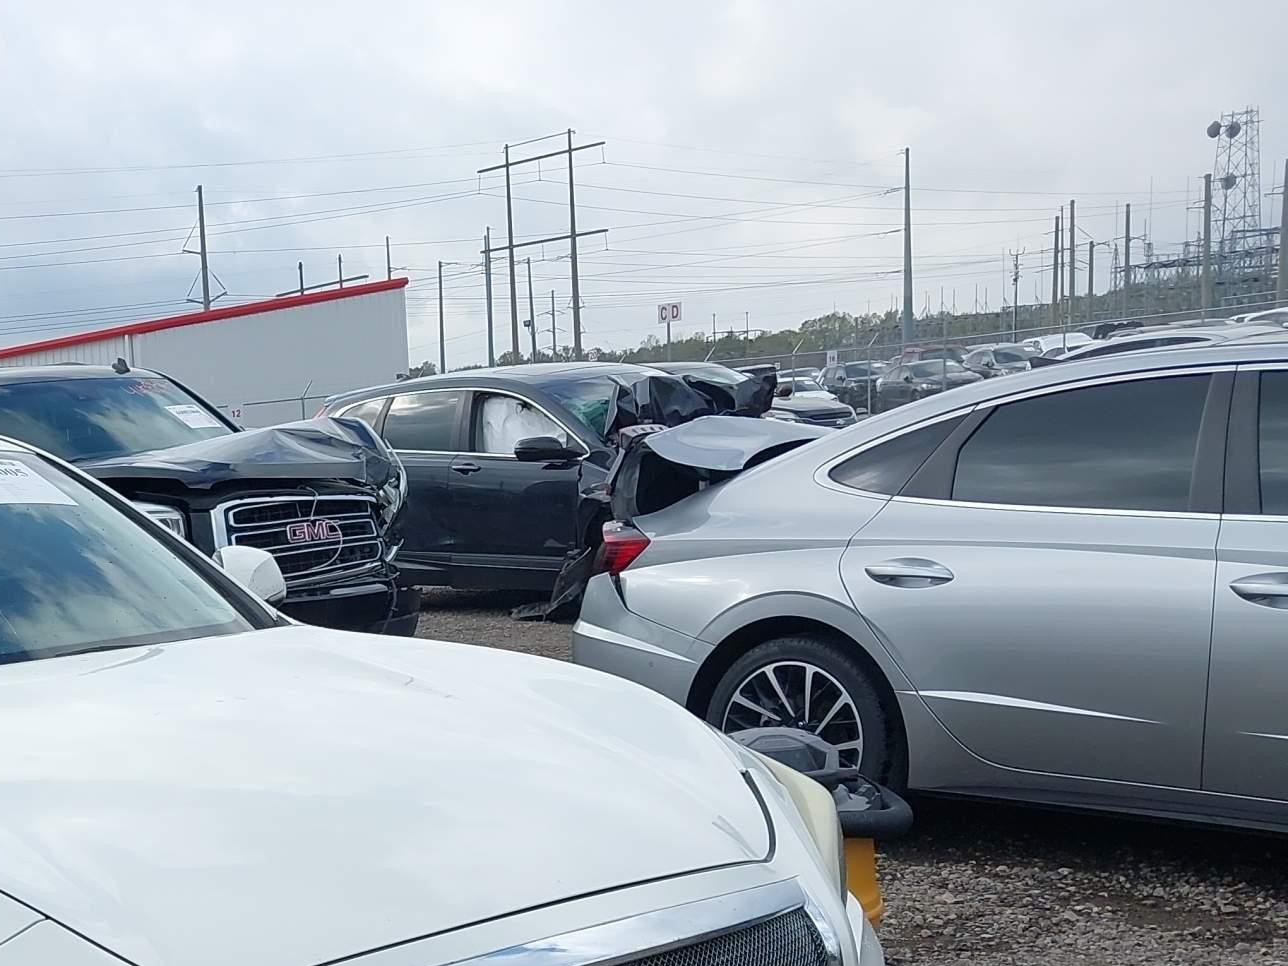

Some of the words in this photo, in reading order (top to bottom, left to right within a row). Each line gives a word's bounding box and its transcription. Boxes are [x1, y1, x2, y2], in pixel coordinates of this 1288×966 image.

[660, 306, 667, 321] C
[671, 304, 679, 319] D
[231, 409, 241, 418] 12
[286, 520, 342, 543] GMC
